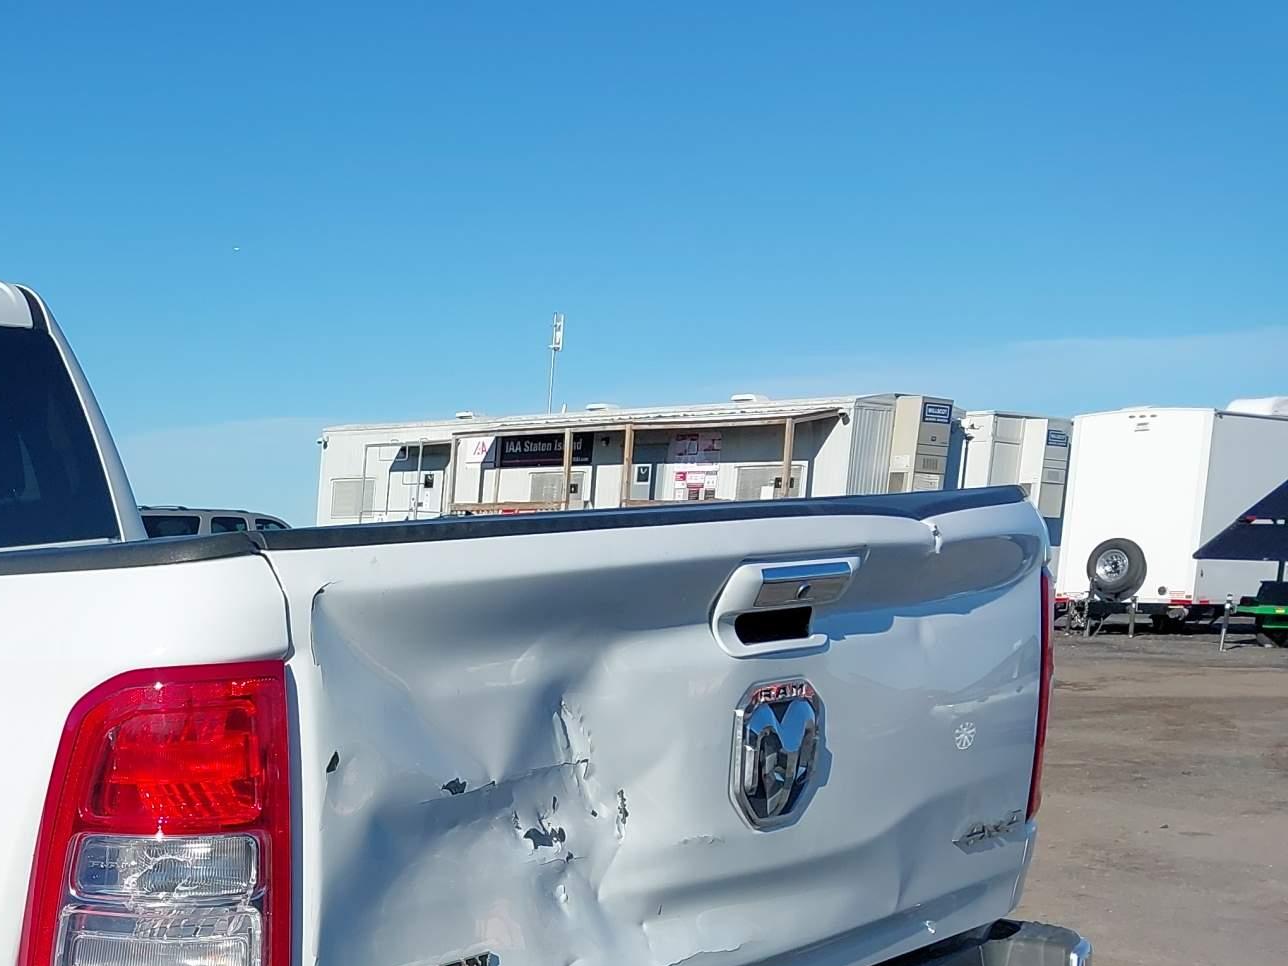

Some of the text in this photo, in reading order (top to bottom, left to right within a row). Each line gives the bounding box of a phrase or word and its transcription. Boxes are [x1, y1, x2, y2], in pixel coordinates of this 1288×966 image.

[505, 440, 522, 453] IAA
[523, 439, 552, 452] Staten
[758, 682, 807, 702] RAM
